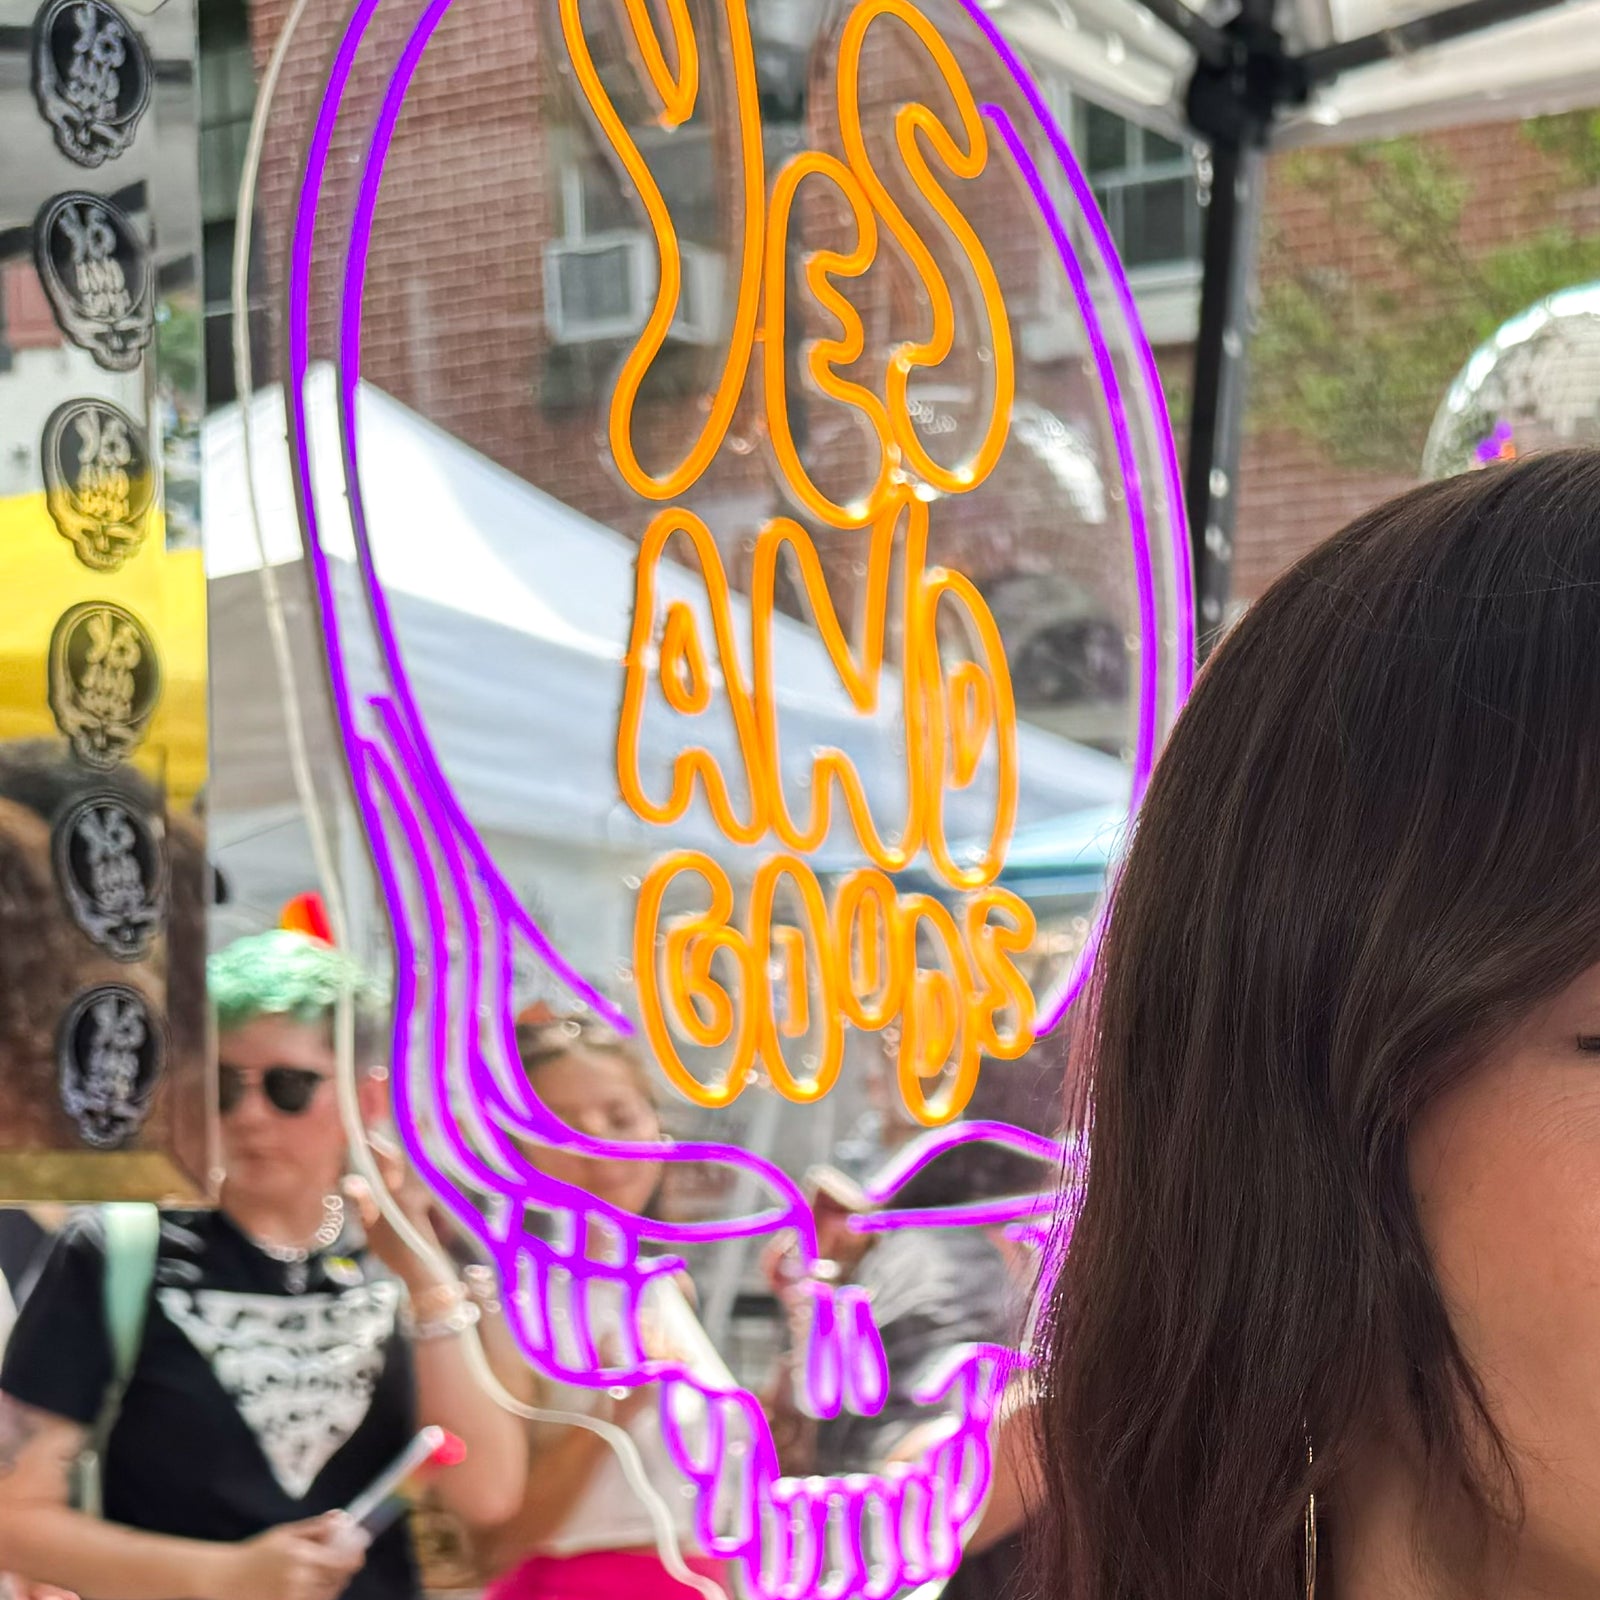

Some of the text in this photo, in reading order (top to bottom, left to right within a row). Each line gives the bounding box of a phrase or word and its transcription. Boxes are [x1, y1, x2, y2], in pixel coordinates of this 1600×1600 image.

[558, 0, 1016, 529] YES
[617, 494, 1018, 891] AND
[634, 848, 1037, 1127] GOODS
